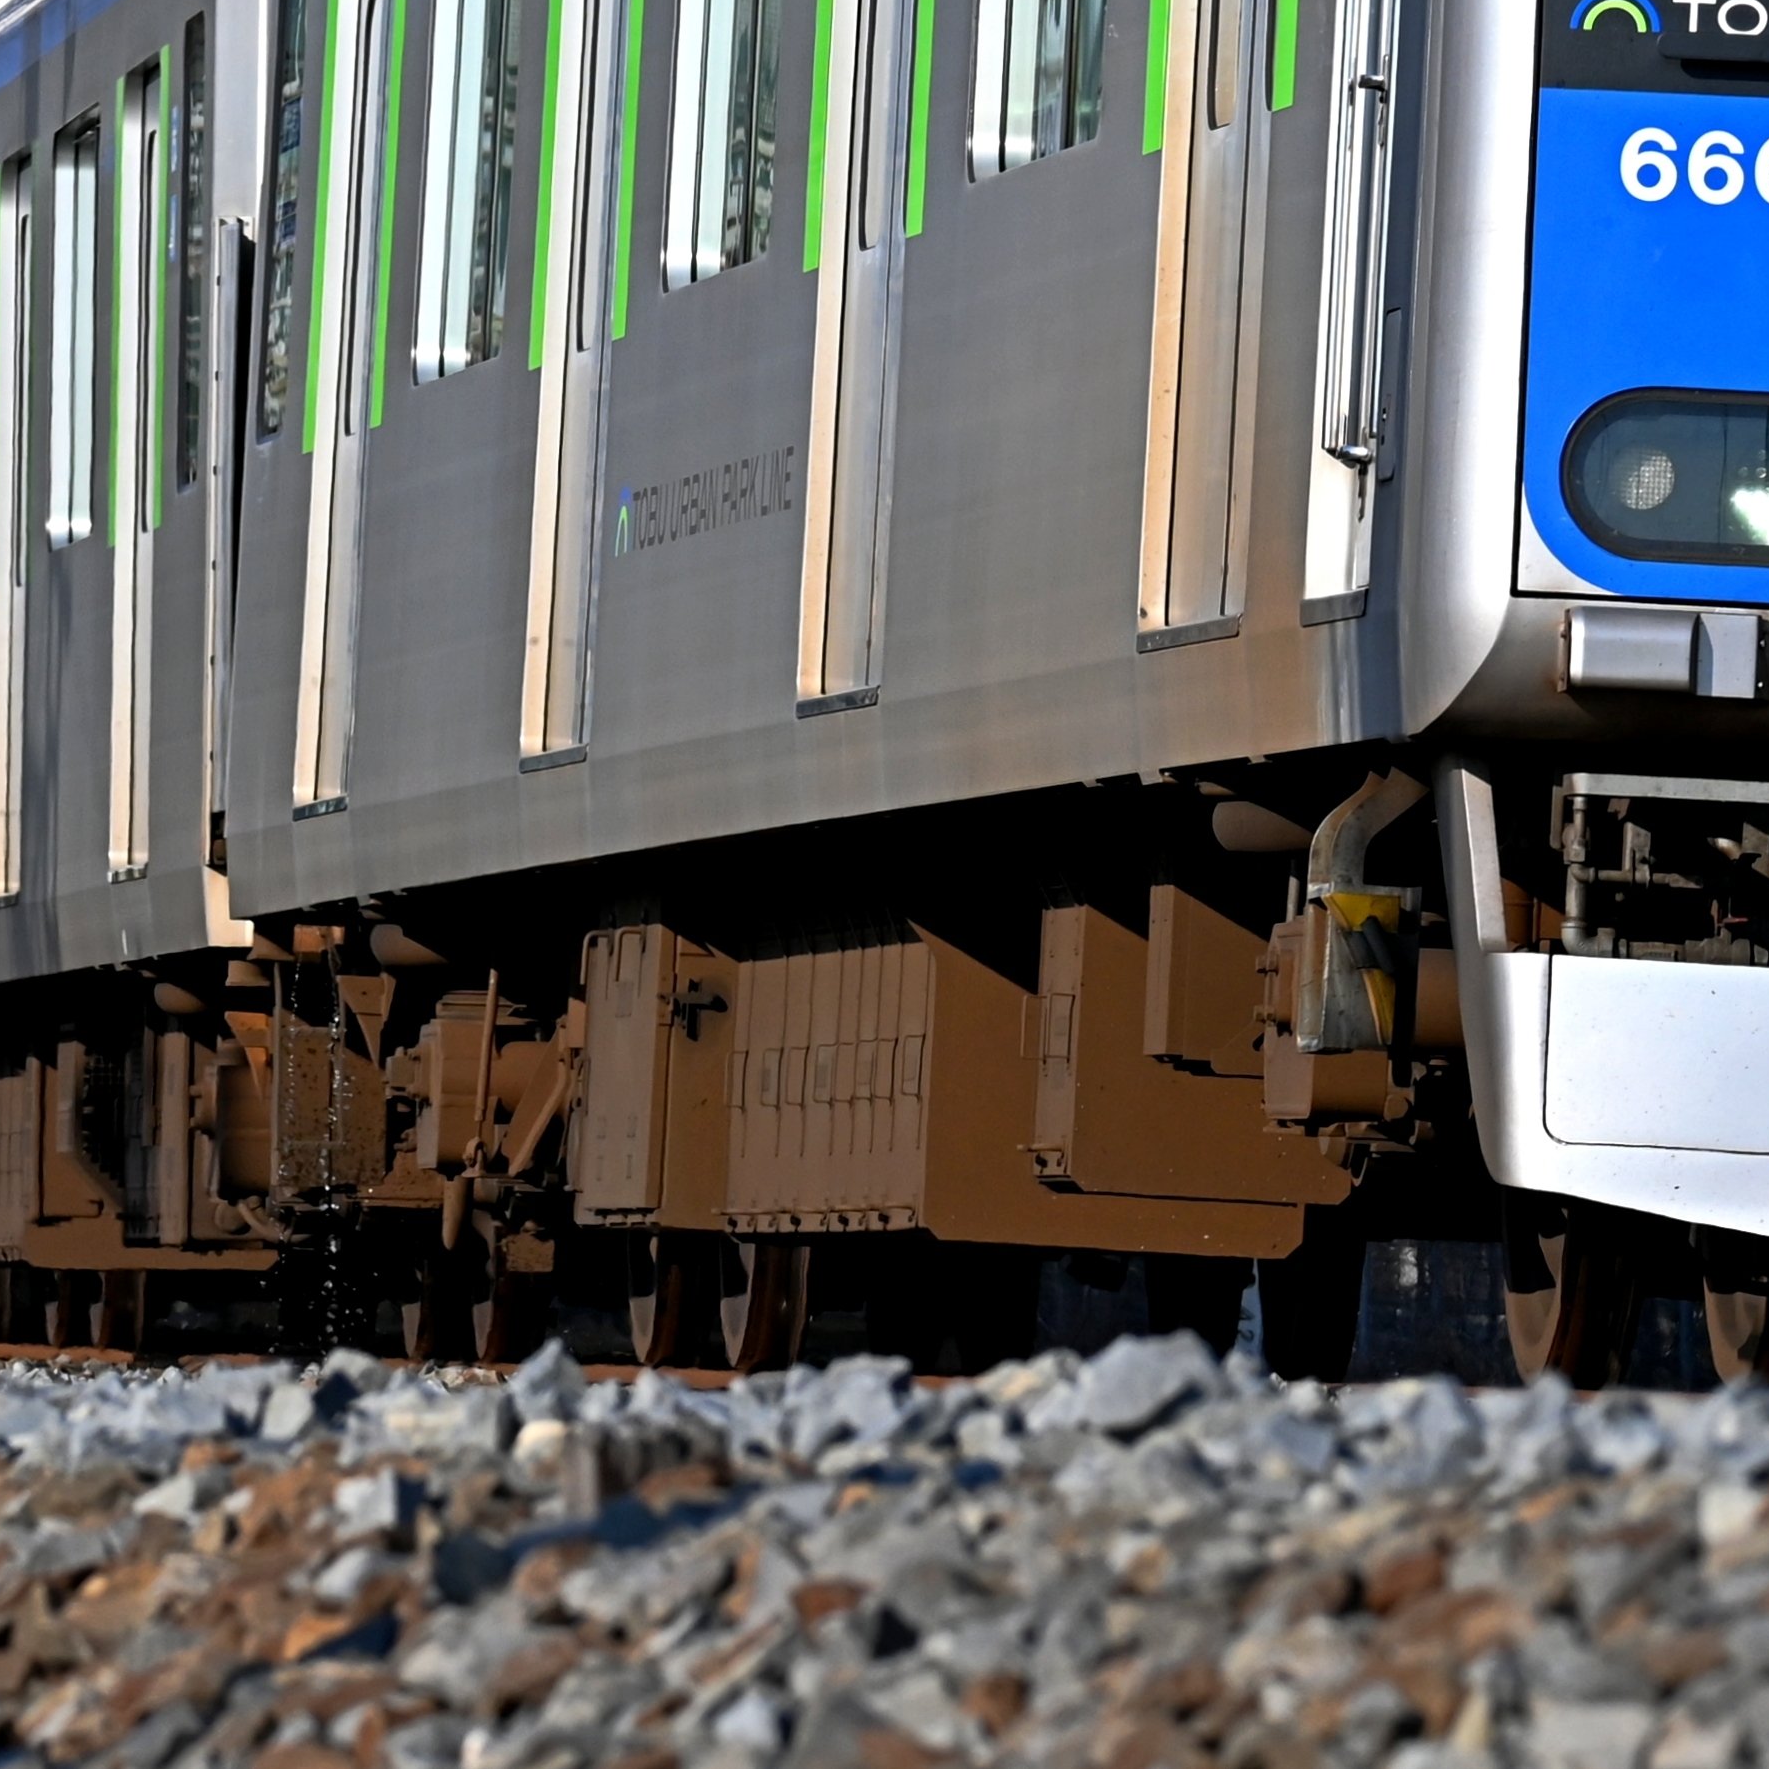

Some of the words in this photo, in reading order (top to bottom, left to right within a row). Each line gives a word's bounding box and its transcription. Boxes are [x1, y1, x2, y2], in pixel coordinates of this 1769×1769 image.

[633, 485, 670, 550] TOBU
[670, 467, 720, 540] URBAN
[721, 455, 759, 525] PARK
[760, 445, 794, 517] LINE
